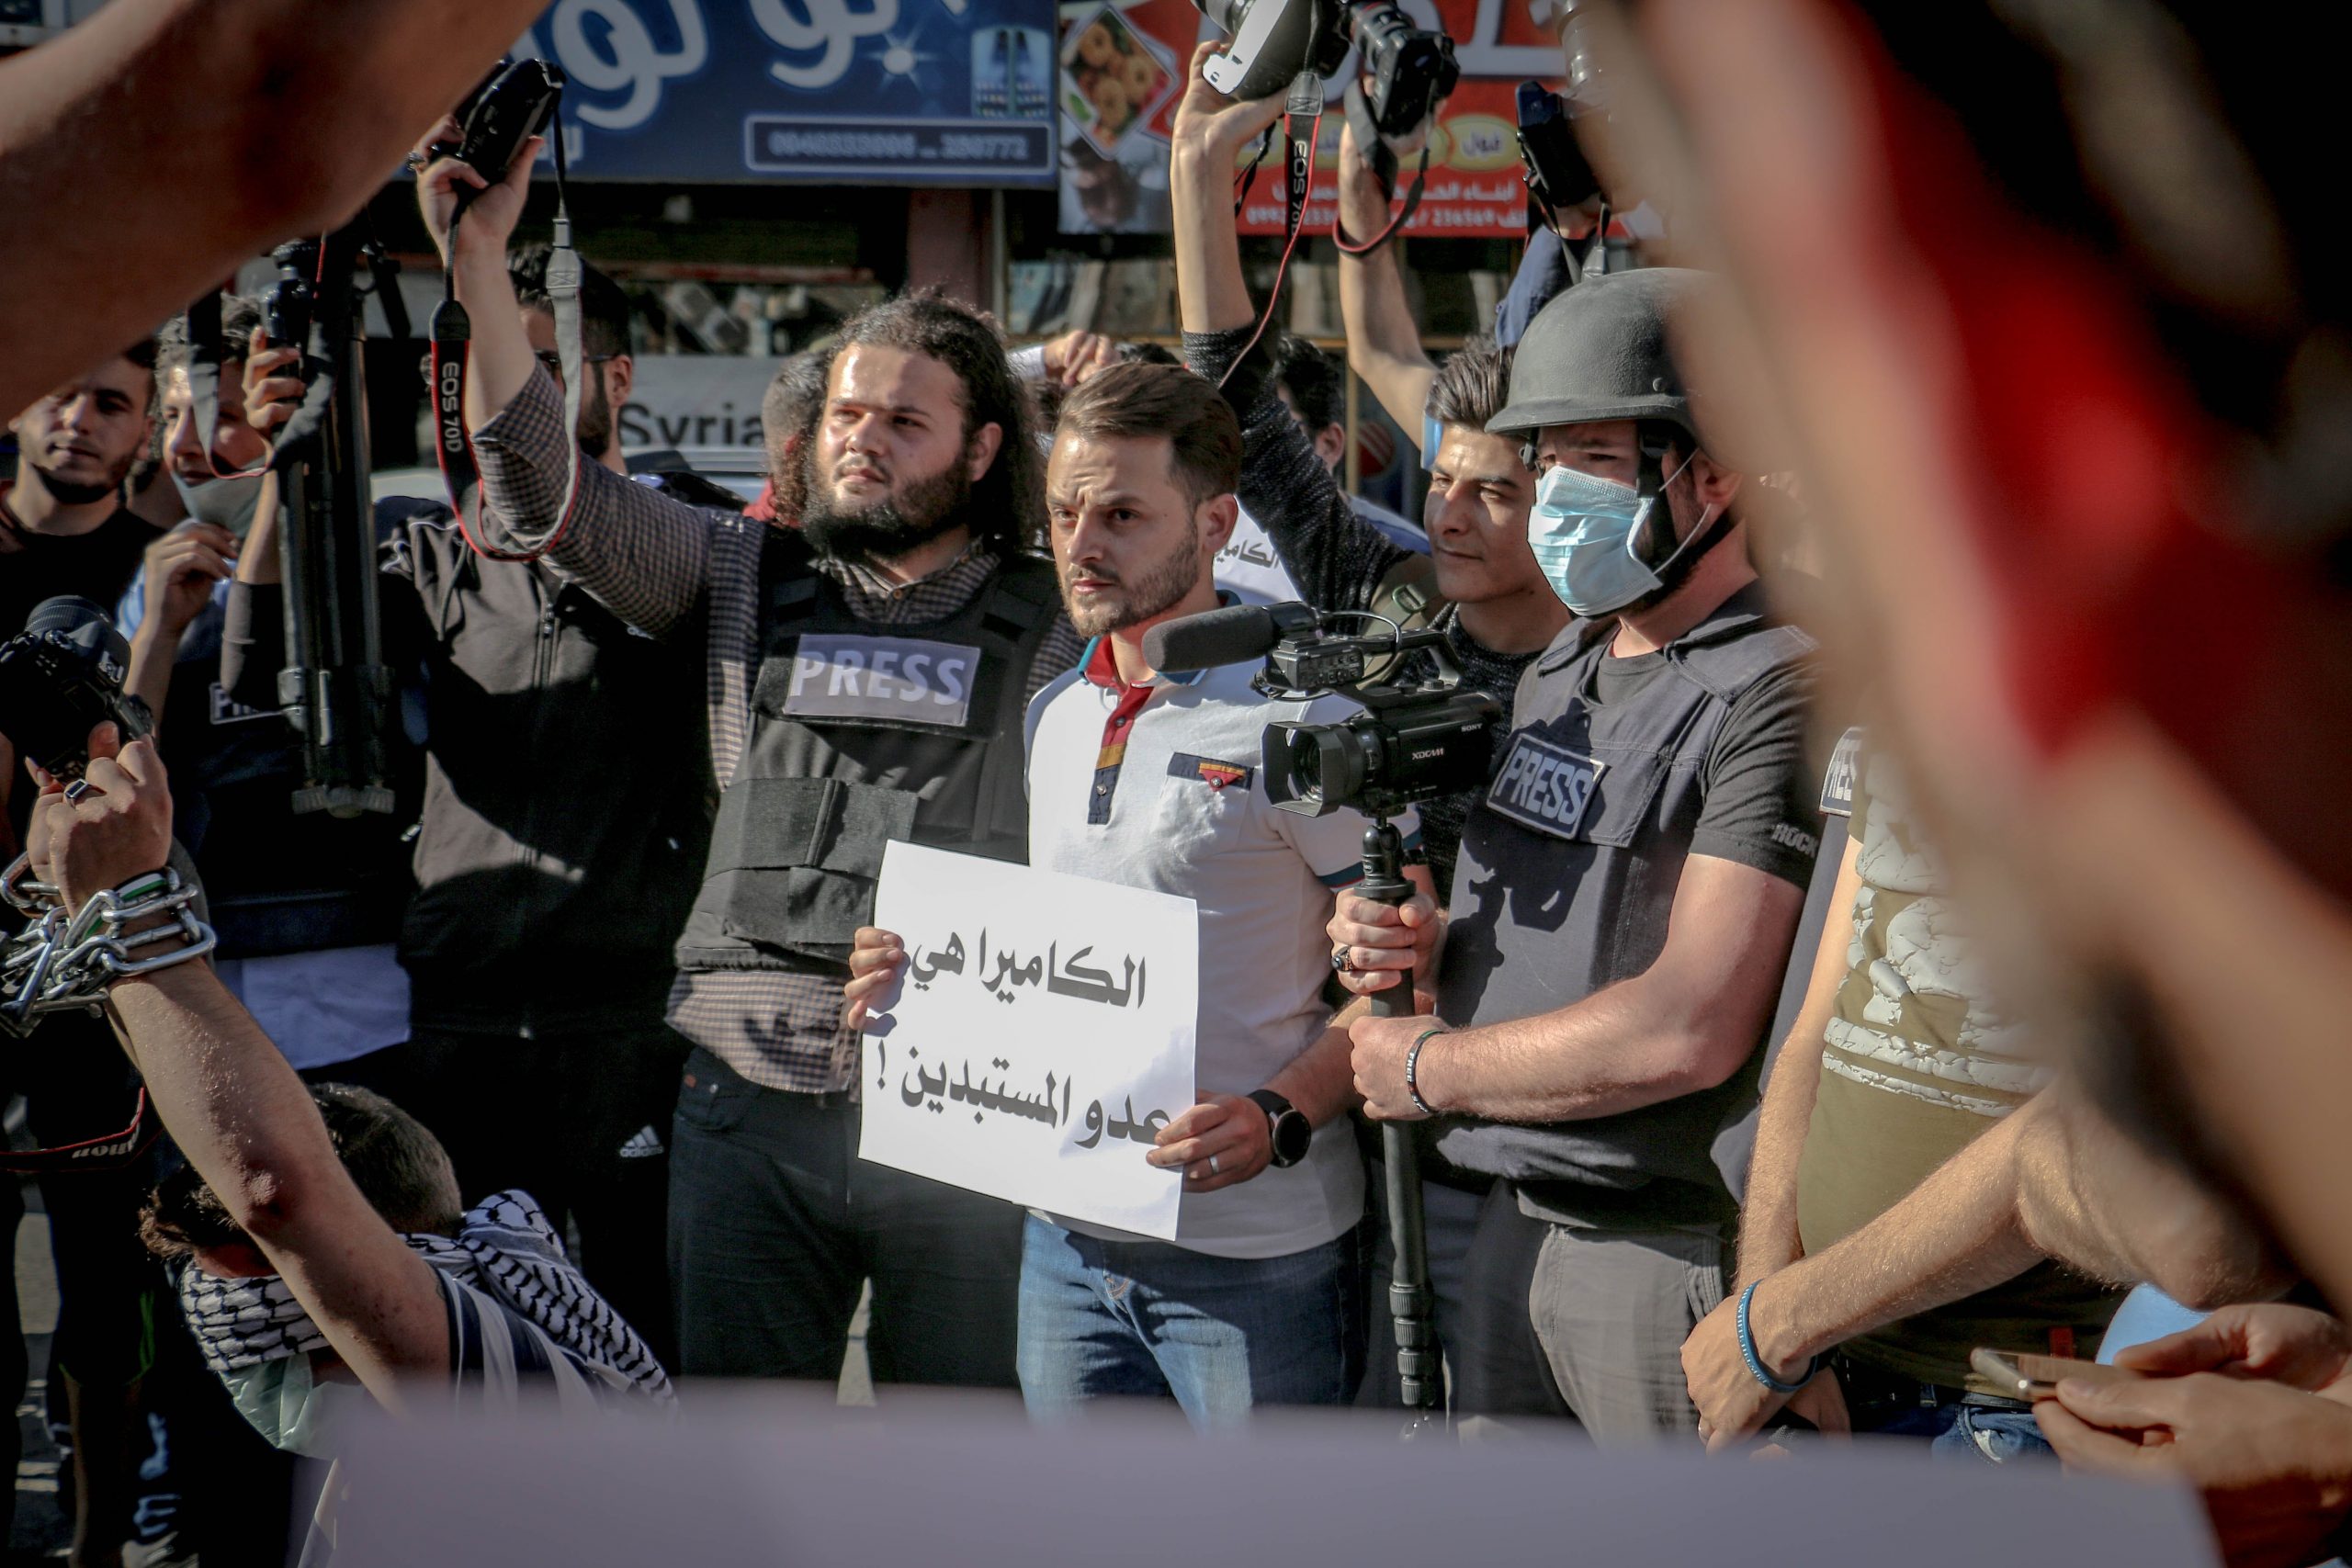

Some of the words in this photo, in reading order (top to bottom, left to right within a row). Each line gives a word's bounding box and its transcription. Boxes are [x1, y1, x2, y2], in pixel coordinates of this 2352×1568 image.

[1294, 141, 1307, 195] EOS
[441, 362, 460, 412] EOS
[444, 416, 464, 453] 70D
[789, 649, 966, 706] PRESS
[1412, 747, 1444, 761] XDCAM
[1461, 723, 1483, 733] SONY
[1494, 746, 1594, 826] PRESS
[910, 931, 966, 992] هي
[978, 926, 1147, 1010] الكاميرا
[900, 1045, 1071, 1130] المستبدين
[1073, 1093, 1170, 1149] عدو
